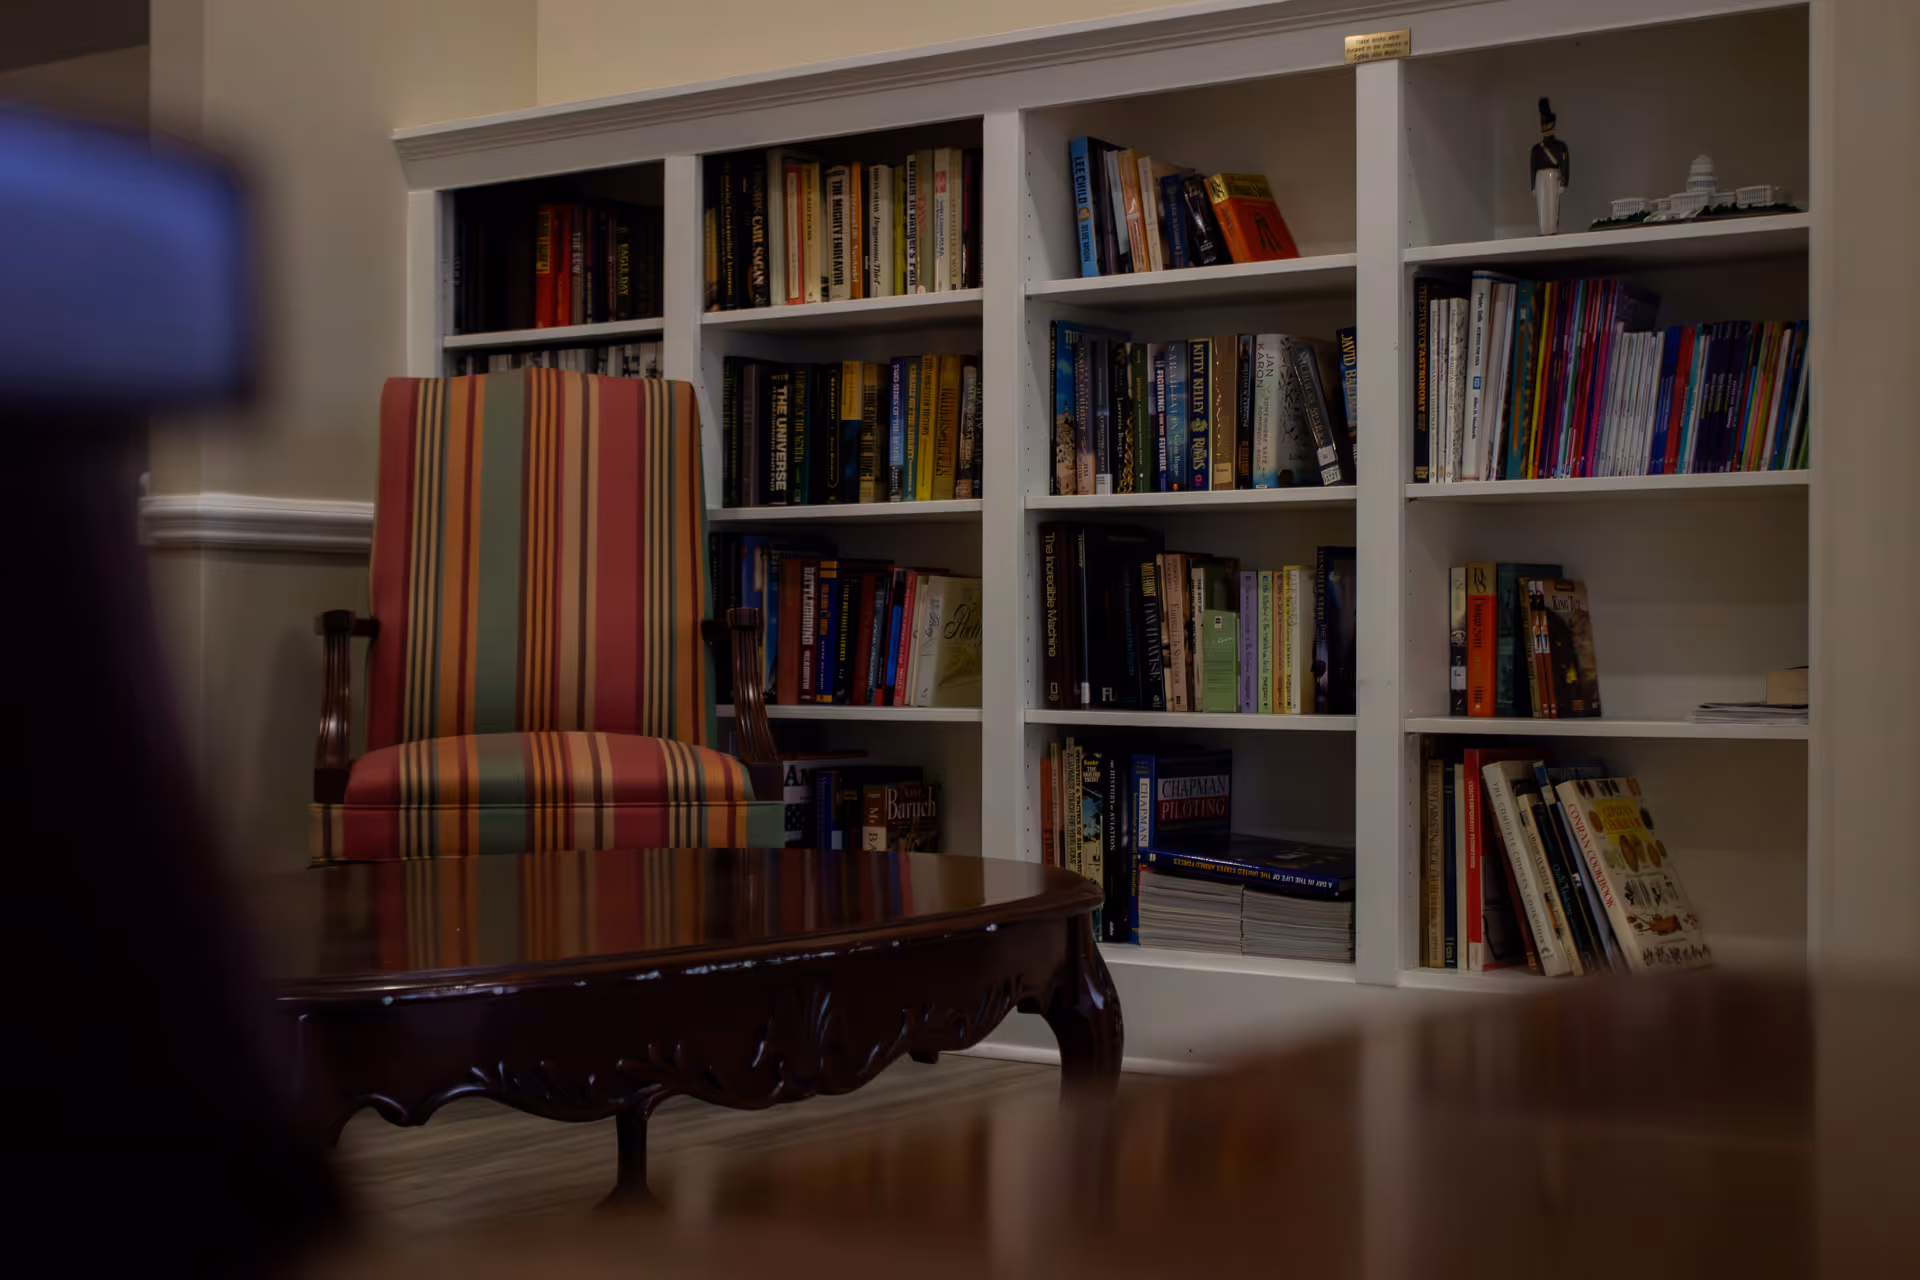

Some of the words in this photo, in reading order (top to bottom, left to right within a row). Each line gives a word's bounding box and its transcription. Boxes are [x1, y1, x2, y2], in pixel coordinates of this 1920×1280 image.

[1074, 155, 1086, 176] LEE
[832, 179, 842, 197] THE
[1076, 177, 1088, 204] CHILD
[752, 215, 763, 246] CARL
[832, 198, 843, 235] MIGHTY
[617, 242, 629, 274] EAGLE
[752, 246, 763, 285] SAGAN
[832, 237, 843, 286] ENDEAVOR
[618, 276, 629, 297] DAY
[1477, 292, 1485, 309] Plain
[1418, 305, 1427, 336] STORY
[1168, 344, 1178, 387] SARAH
[1193, 343, 1205, 375] KITTY
[1257, 343, 1266, 389] KARON
[1266, 353, 1275, 378] JAN
[1341, 333, 1355, 367] DAVID
[1156, 371, 1165, 413] FIGHTING
[1192, 377, 1205, 415] KELLEY
[1418, 349, 1427, 413] ASTRONOMY
[776, 385, 788, 416] THE
[893, 406, 900, 417] OF
[1169, 389, 1179, 431] PALIN
[1298, 351, 1316, 405] NICHOLAS
[1310, 407, 1326, 446] SPARKS
[922, 410, 930, 437] HISTORY
[776, 417, 788, 491] UNIVERSE
[1159, 437, 1167, 473] FUTURE
[1191, 437, 1206, 470] ROYALS
[1044, 532, 1056, 555] The
[1045, 555, 1057, 608] Incredible
[1139, 561, 1157, 598] MOLEHUNT
[1316, 550, 1324, 594] DANIELLE
[802, 566, 815, 646] BATTLEGROUND
[1552, 594, 1569, 611] KING
[1047, 609, 1059, 658] Machine
[1143, 602, 1158, 641] DAVID
[1147, 642, 1162, 683] WISE
[887, 784, 937, 821] Baruch
[1162, 777, 1226, 798] CHAPMAN
[1139, 782, 1149, 843] CHAPMAN
[1162, 799, 1226, 821] PILOTING
[1492, 781, 1502, 798] THE
[1497, 802, 1515, 848] COMPLETE
[1172, 858, 1195, 868] FORCES
[1195, 861, 1216, 871] ARMED
[1216, 864, 1237, 874] STATES
[1567, 803, 1591, 850] CONRAN
[1587, 849, 1617, 909] COOKBOOK
[1237, 868, 1259, 878] UNITED
[1260, 871, 1271, 880] THE
[1272, 873, 1281, 881] OF
[1281, 874, 1294, 883] LIFE
[1294, 877, 1307, 885] THE
[1315, 879, 1328, 888] DAY
